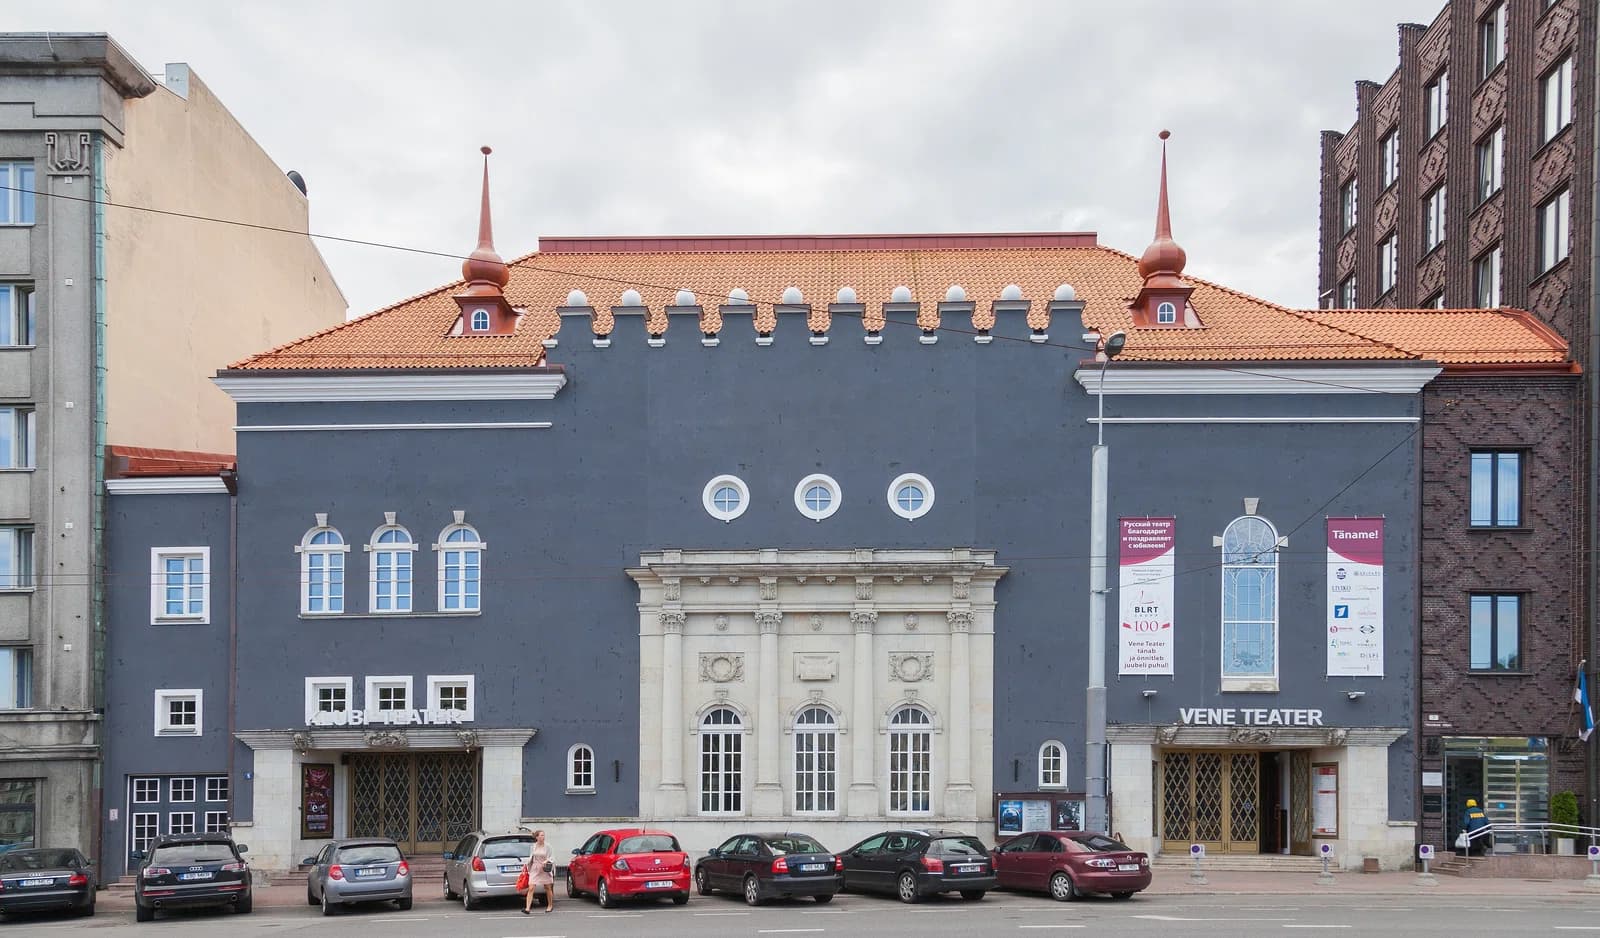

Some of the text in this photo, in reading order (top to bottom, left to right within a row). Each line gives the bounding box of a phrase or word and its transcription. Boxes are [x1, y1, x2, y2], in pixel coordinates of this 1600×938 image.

[1332, 530, 1379, 539] Täname!
[1135, 620, 1159, 632] 100
[380, 709, 463, 725] TEATER
[1179, 708, 1324, 726] VENE TEATER
